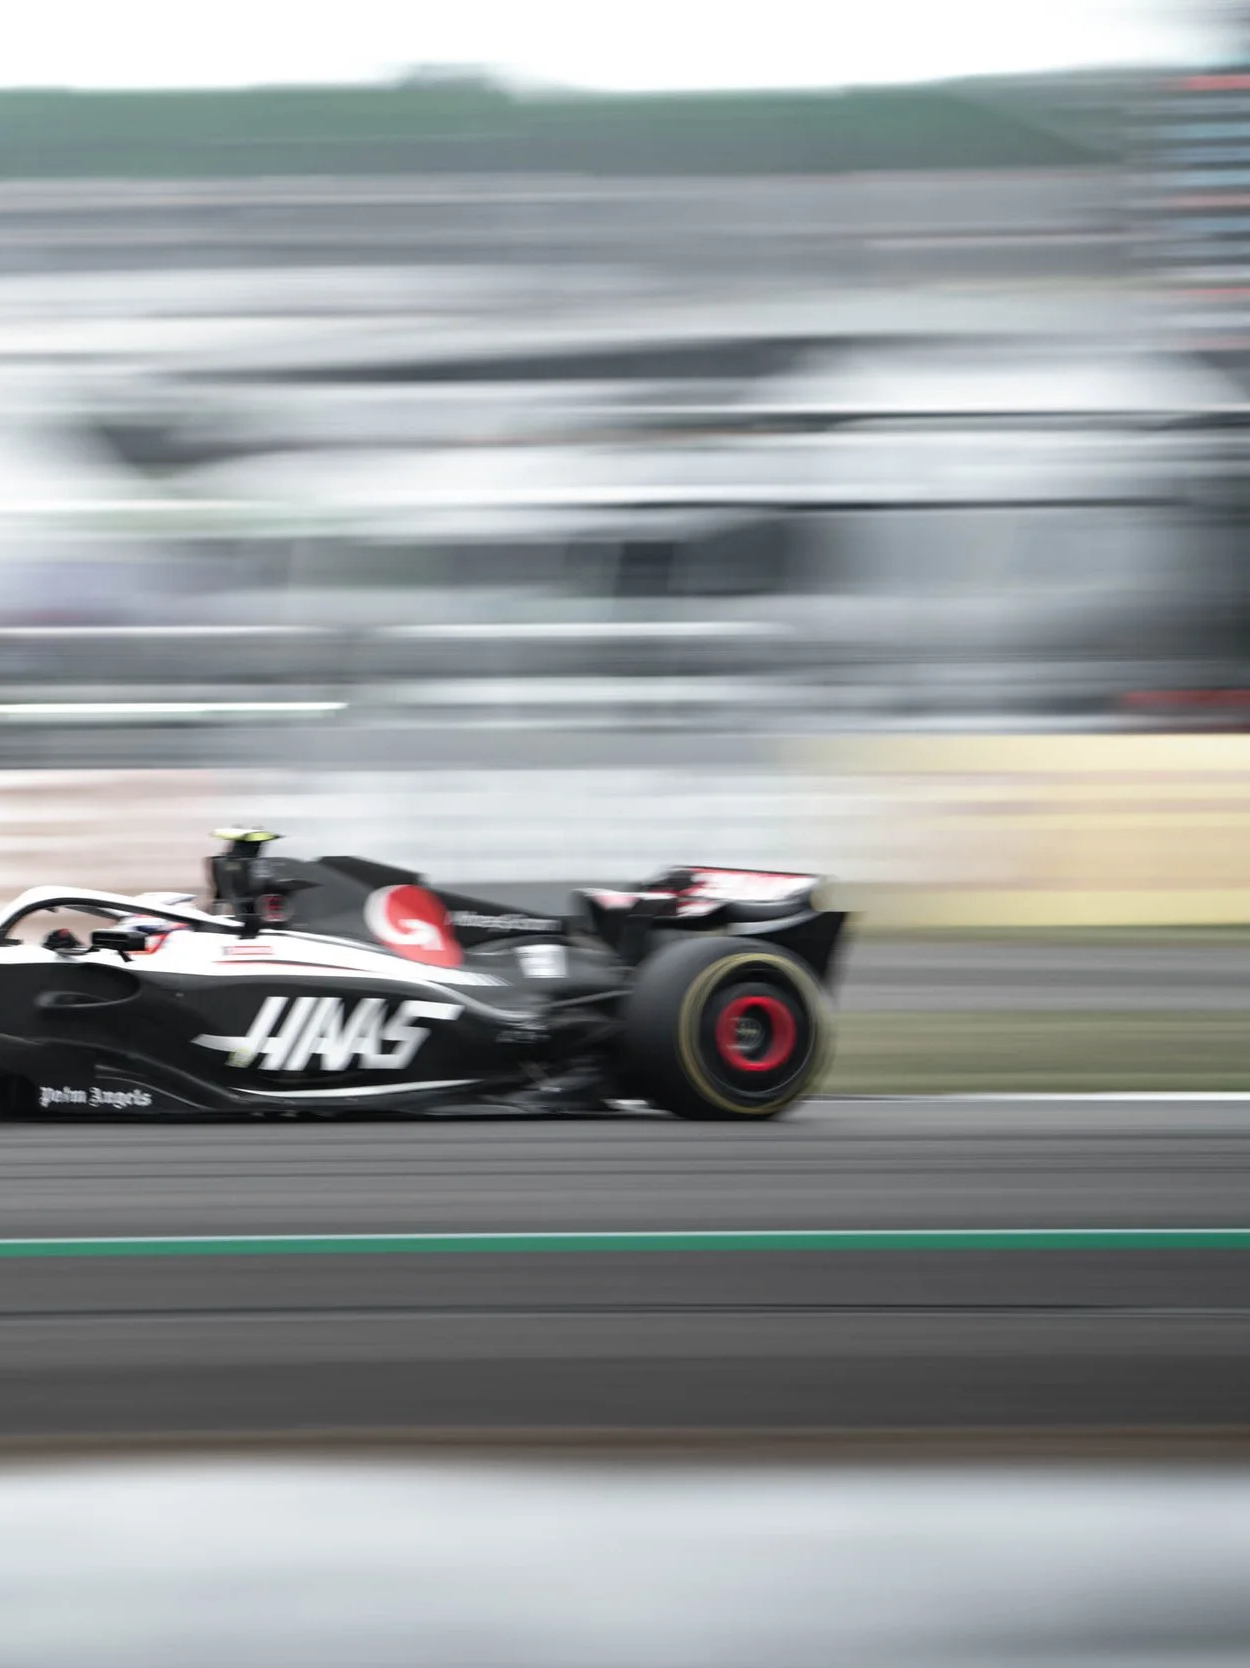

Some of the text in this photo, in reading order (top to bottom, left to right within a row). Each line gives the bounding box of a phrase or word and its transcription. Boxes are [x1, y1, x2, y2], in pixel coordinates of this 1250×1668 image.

[191, 996, 466, 1071] HAAS
[39, 1086, 152, 1109] Palm Angels
